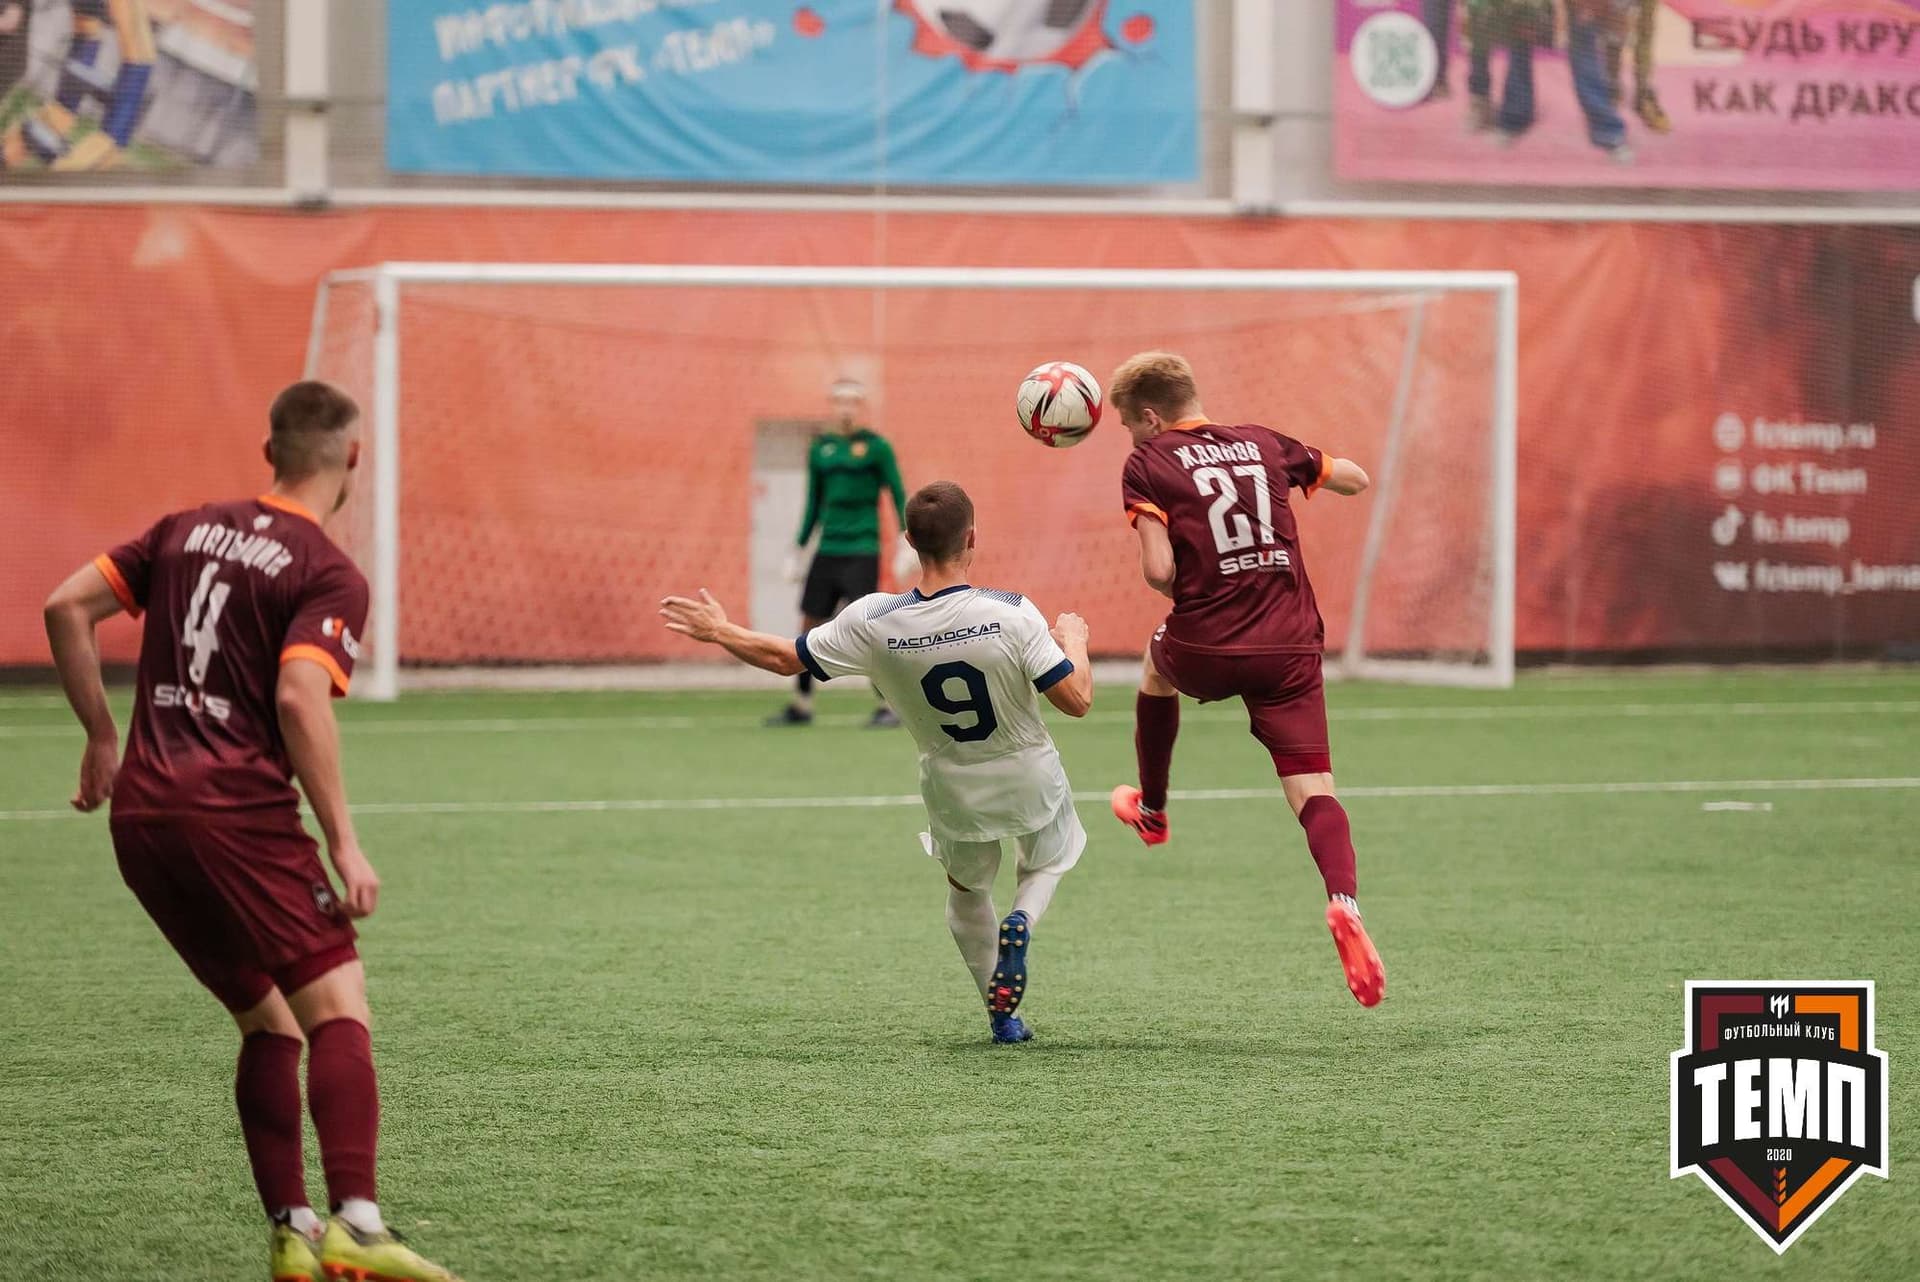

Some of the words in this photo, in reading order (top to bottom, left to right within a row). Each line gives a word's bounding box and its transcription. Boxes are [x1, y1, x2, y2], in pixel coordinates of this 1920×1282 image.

[1691, 17, 1825, 61] БУДЬ
[1693, 80, 1776, 114] КАК
[1192, 463, 1276, 555] 27
[1218, 549, 1290, 575] SEUS
[181, 560, 231, 685] 4
[920, 660, 998, 742] 9
